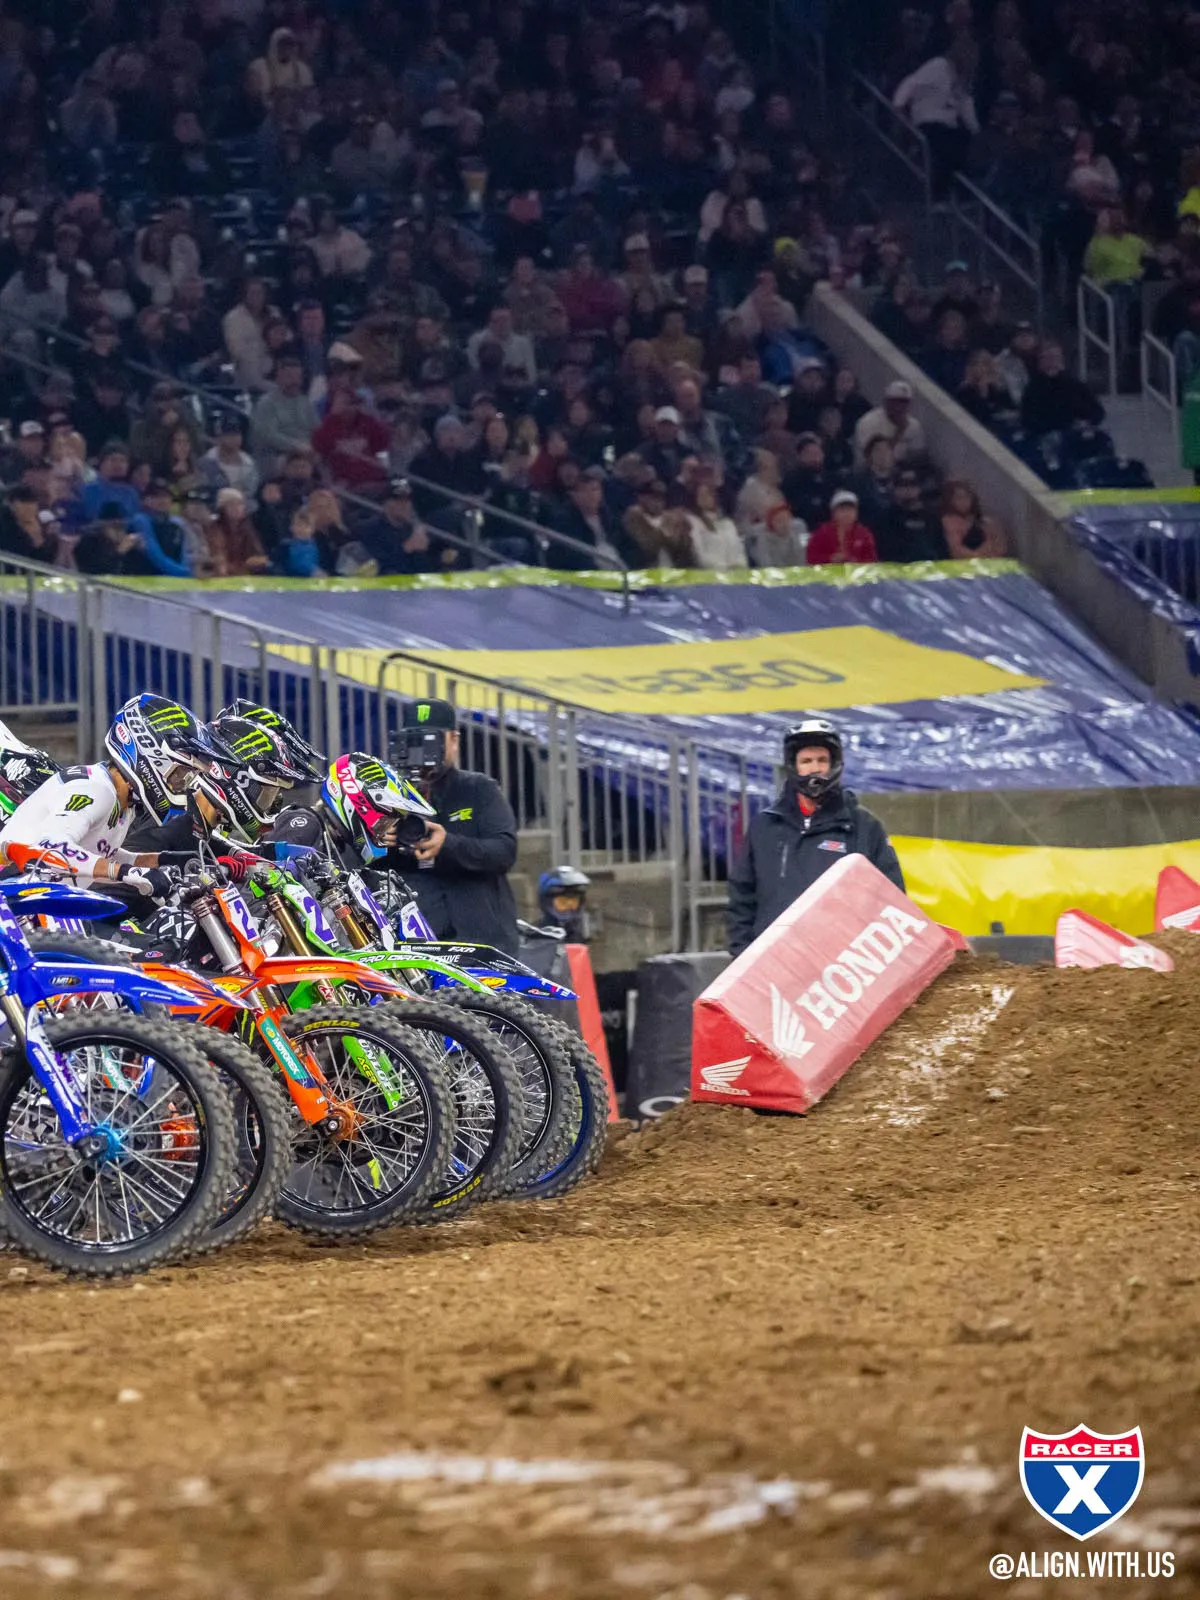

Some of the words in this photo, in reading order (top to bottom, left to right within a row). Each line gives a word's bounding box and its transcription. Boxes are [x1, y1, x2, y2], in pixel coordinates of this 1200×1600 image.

[138, 759, 164, 798] MONSTER
[227, 786, 255, 821] MONSTER
[796, 905, 929, 1031] HONDA
[303, 1019, 361, 1032] DUNLOP
[271, 1036, 300, 1075] MOTOREX
[700, 1082, 751, 1097] HONDA
